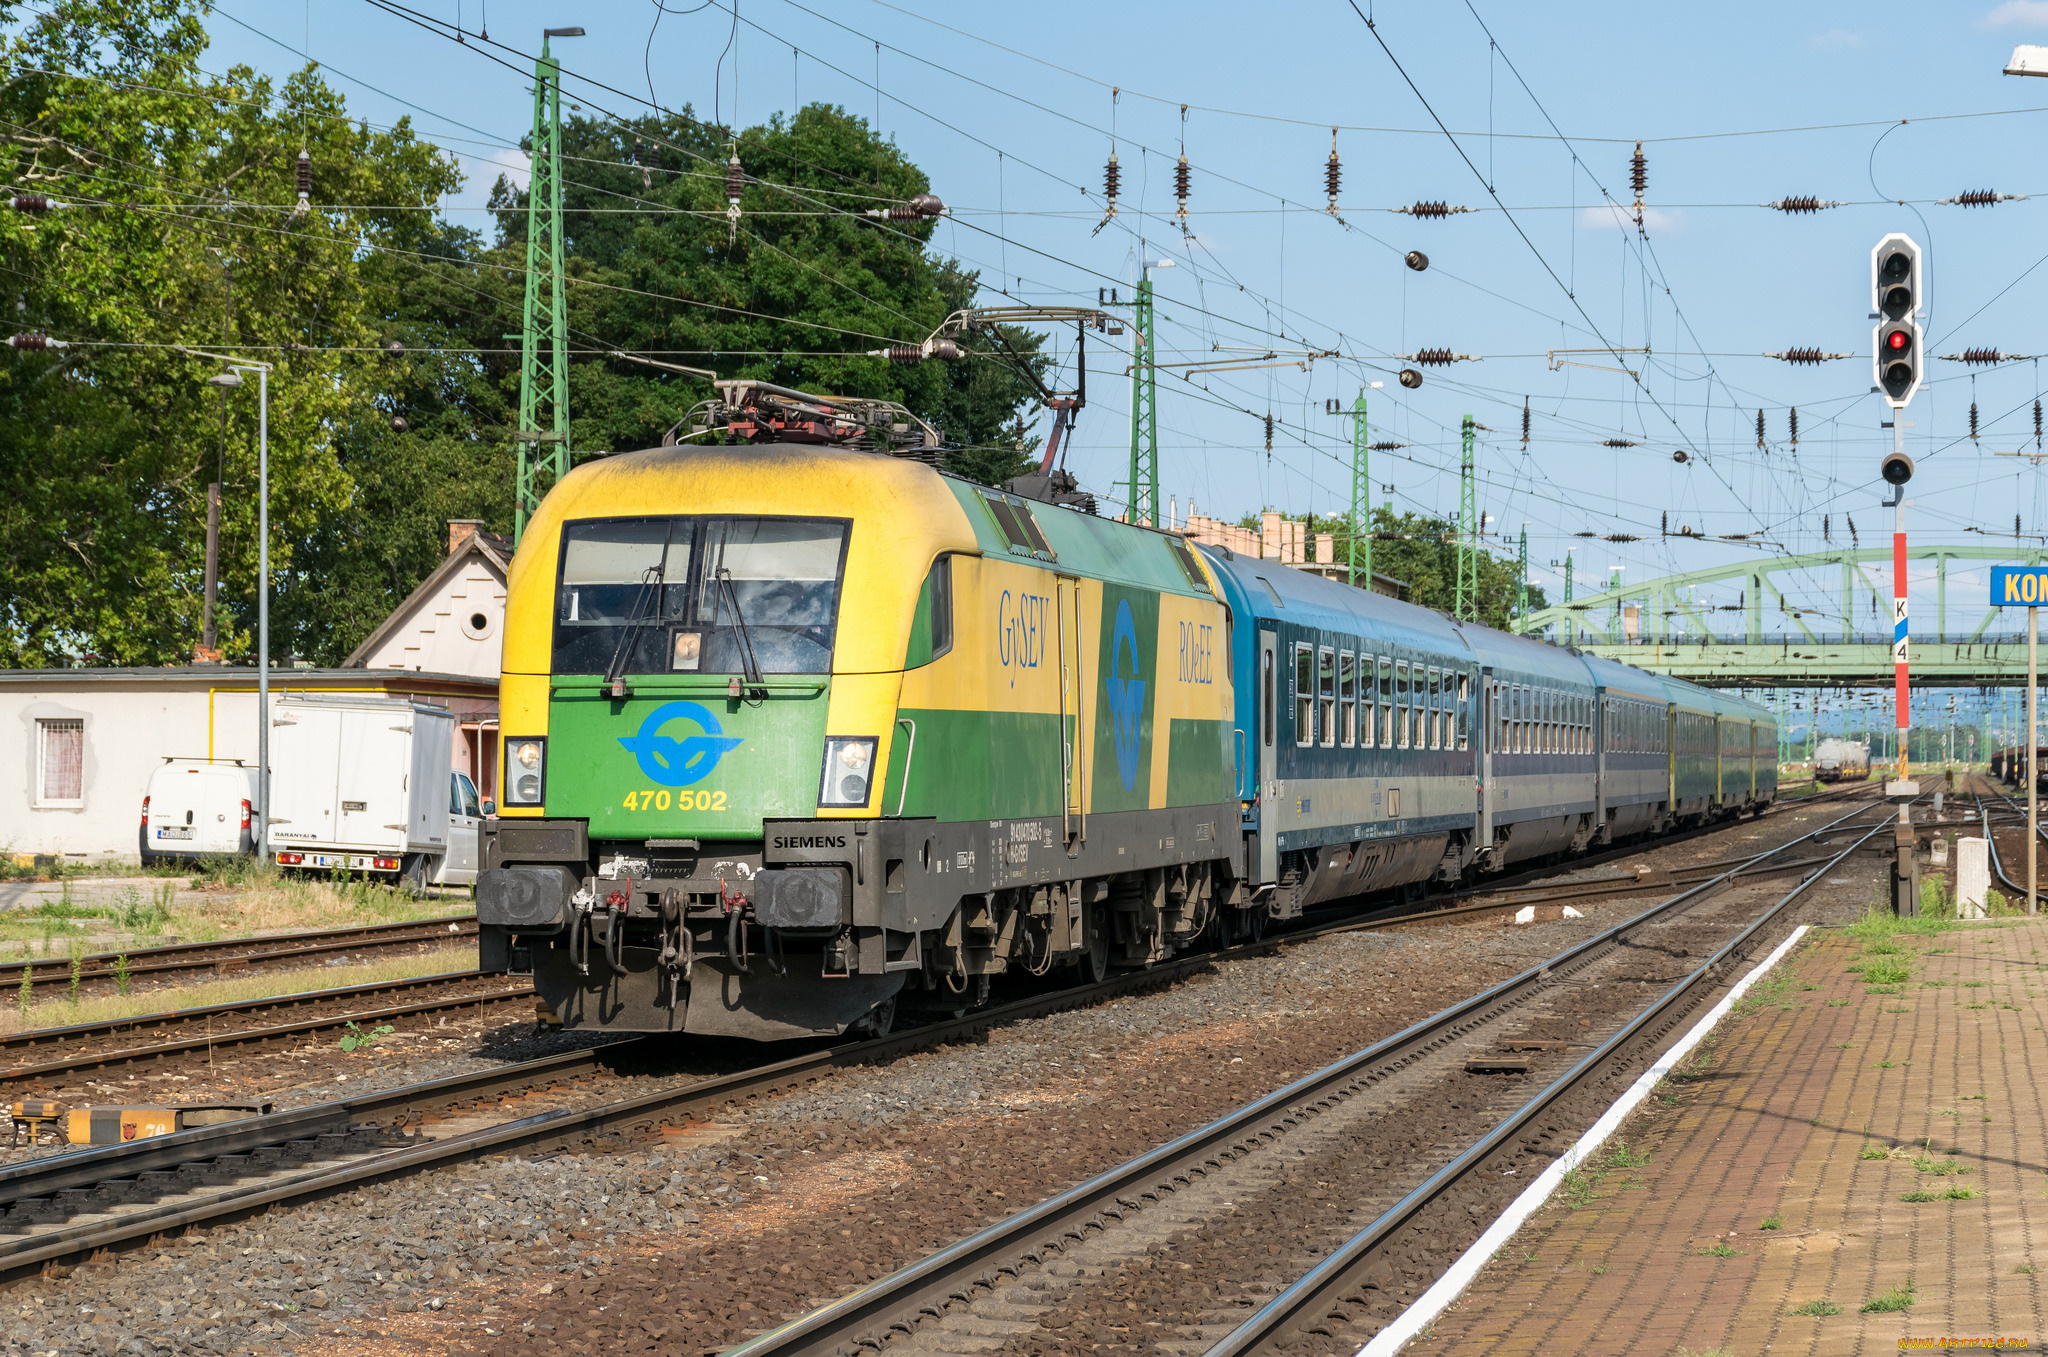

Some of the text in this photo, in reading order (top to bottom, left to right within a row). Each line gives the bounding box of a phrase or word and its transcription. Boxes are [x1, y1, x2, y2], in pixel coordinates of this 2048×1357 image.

[1896, 601, 1905, 617] K
[999, 589, 1049, 689] GySEV
[1179, 621, 1212, 684] ROeEE
[1897, 644, 1906, 660] 4
[622, 790, 727, 811] 470 502
[774, 836, 846, 849] SIEMENS
